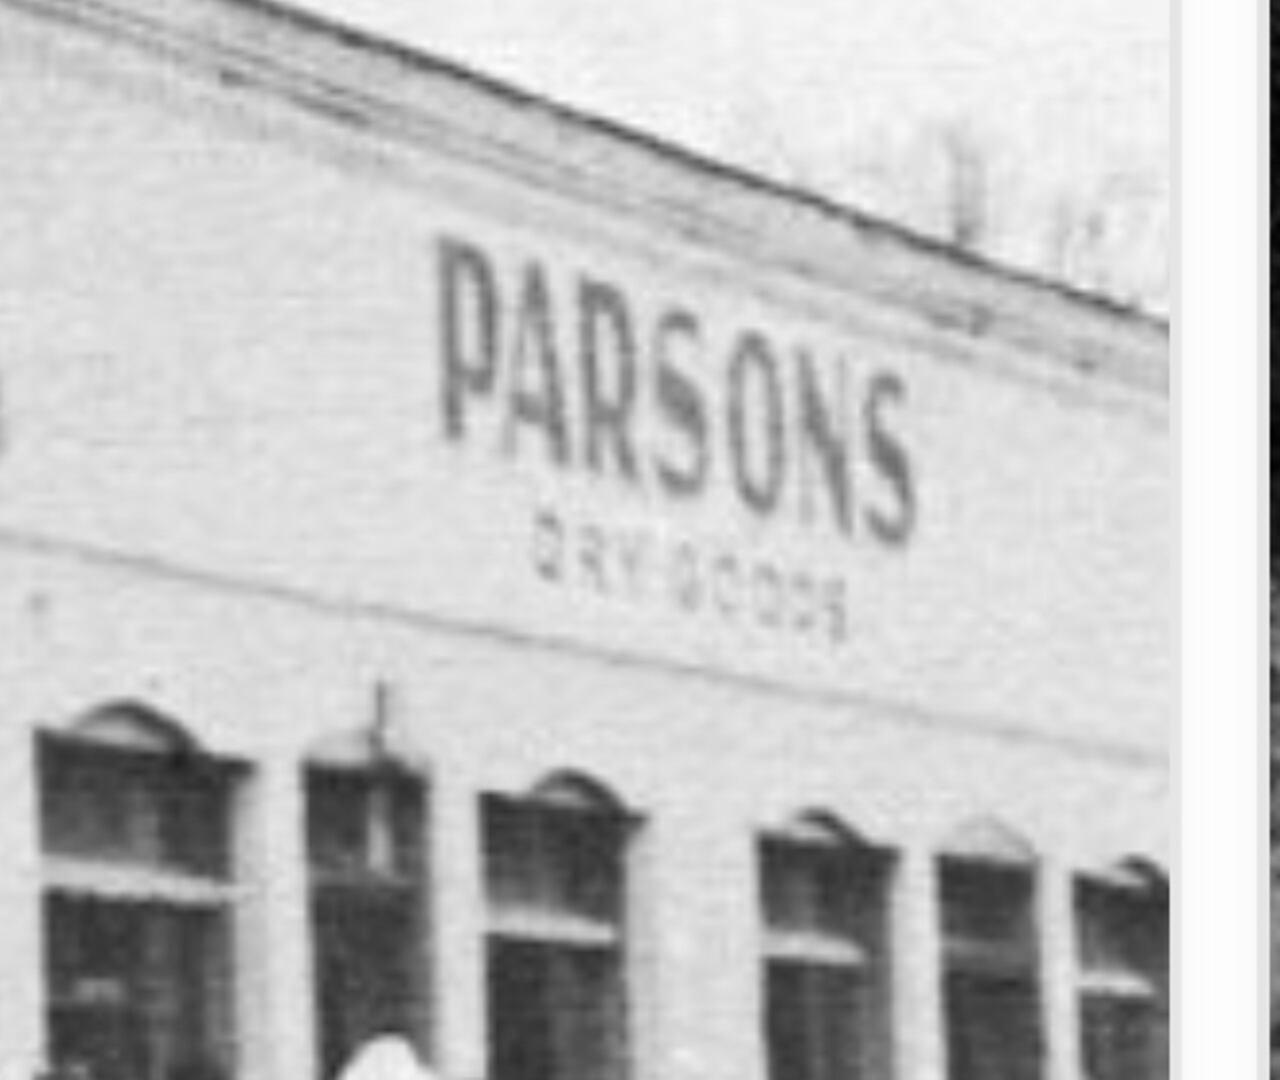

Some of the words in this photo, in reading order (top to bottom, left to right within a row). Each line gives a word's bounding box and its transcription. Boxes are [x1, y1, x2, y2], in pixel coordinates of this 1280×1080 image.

[436, 234, 918, 547] PARSONS
[532, 508, 646, 602] DRY
[674, 538, 850, 644] GOODS
